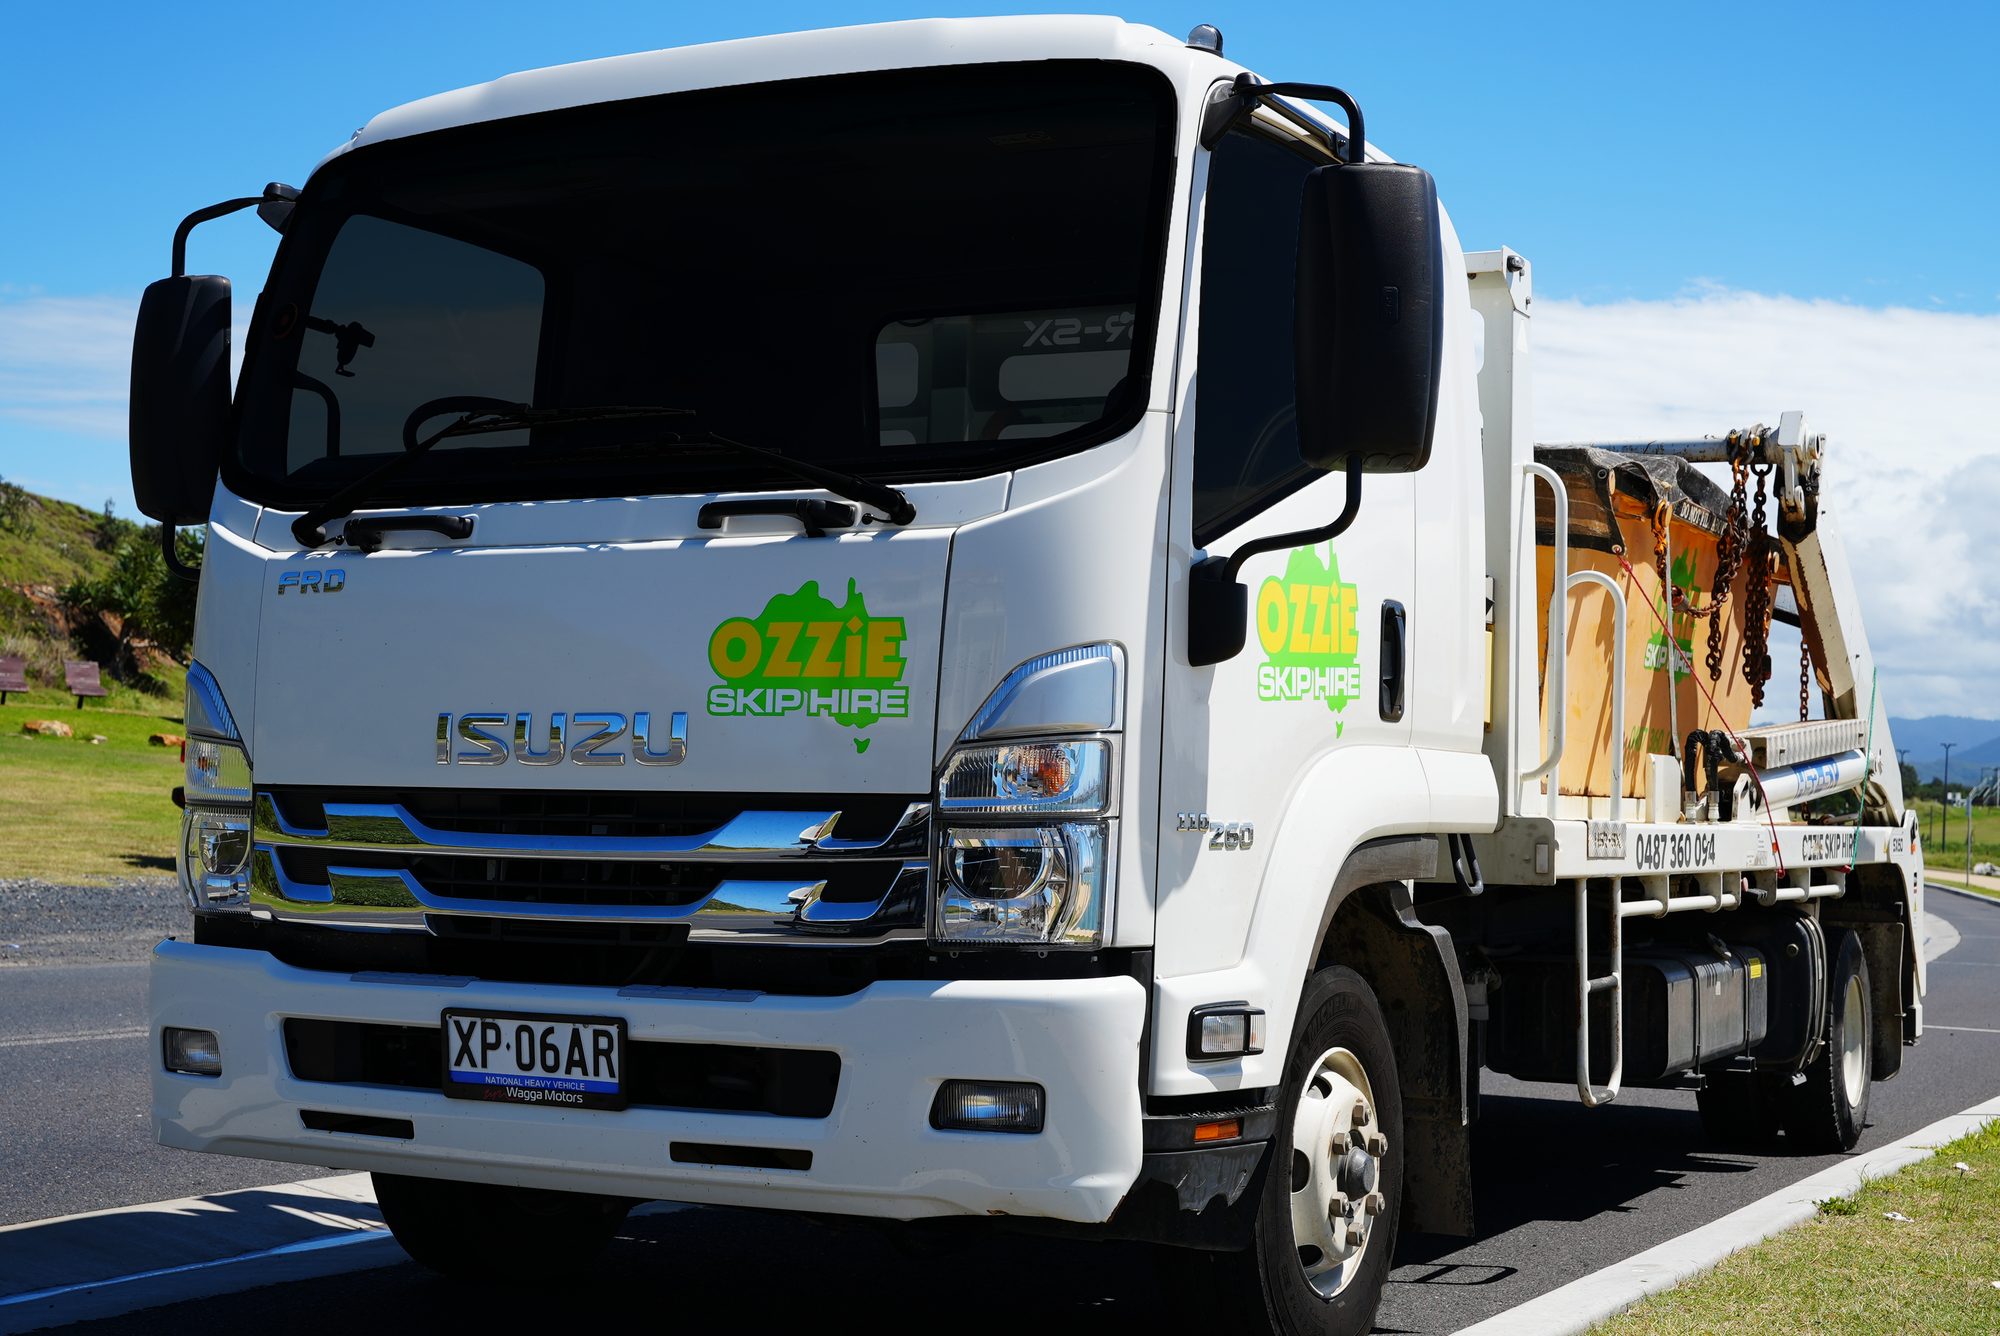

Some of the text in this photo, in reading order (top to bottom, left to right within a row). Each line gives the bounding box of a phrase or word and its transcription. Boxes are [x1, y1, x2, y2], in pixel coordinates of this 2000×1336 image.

[278, 569, 345, 595] FRD
[1643, 643, 1668, 669] SKIP
[1258, 666, 1360, 698] SKIP HIRE
[709, 688, 906, 714] SKIP HIRE
[437, 712, 688, 766] ISUZU
[1176, 812, 1254, 851] 110 260
[1636, 833, 1667, 870] 0487
[1670, 833, 1691, 869] 360
[1825, 833, 1841, 859] SKIP
[485, 1075, 585, 1091] NATIONAL HEAVY VEHICLE
[506, 1086, 543, 1101] Wagga
[544, 1090, 583, 1103] Motors
